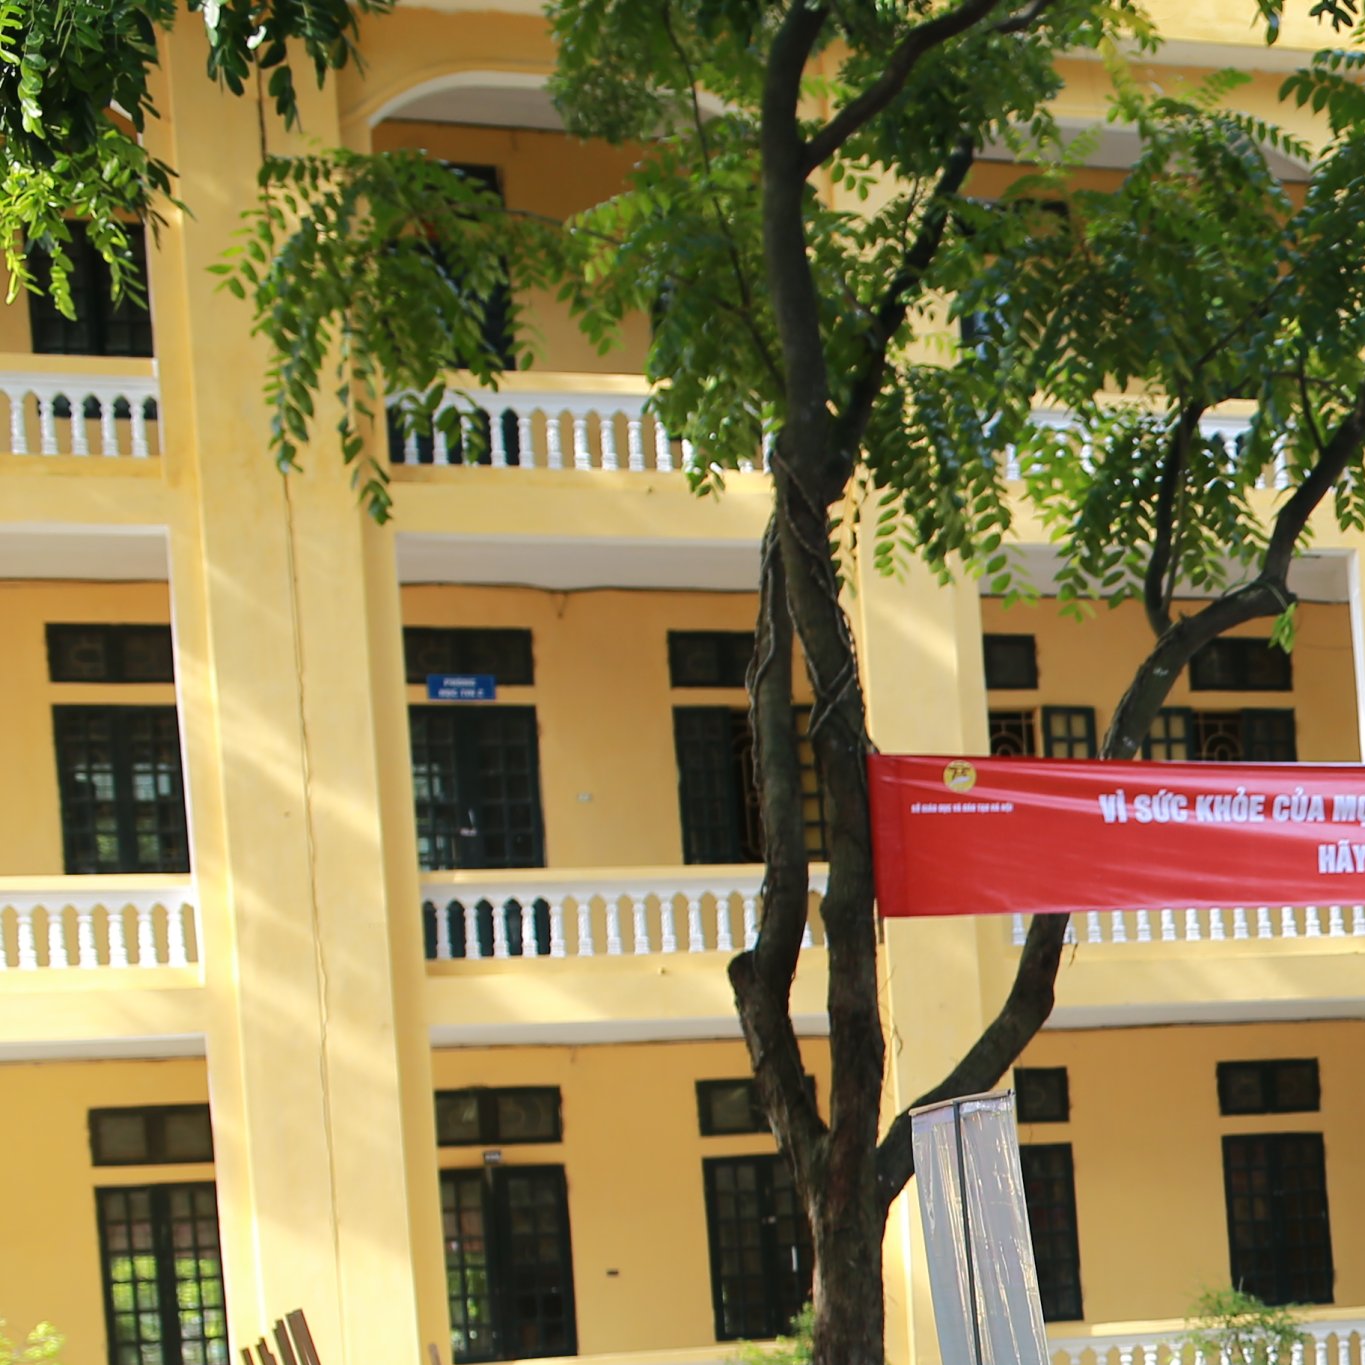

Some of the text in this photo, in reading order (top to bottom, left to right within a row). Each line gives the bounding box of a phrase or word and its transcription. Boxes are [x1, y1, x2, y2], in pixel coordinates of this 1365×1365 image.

[1098, 789, 1128, 823] VÌ
[1133, 789, 1189, 823] SỨC
[1195, 786, 1266, 823] KHỎE
[1272, 786, 1325, 823] CỦA
